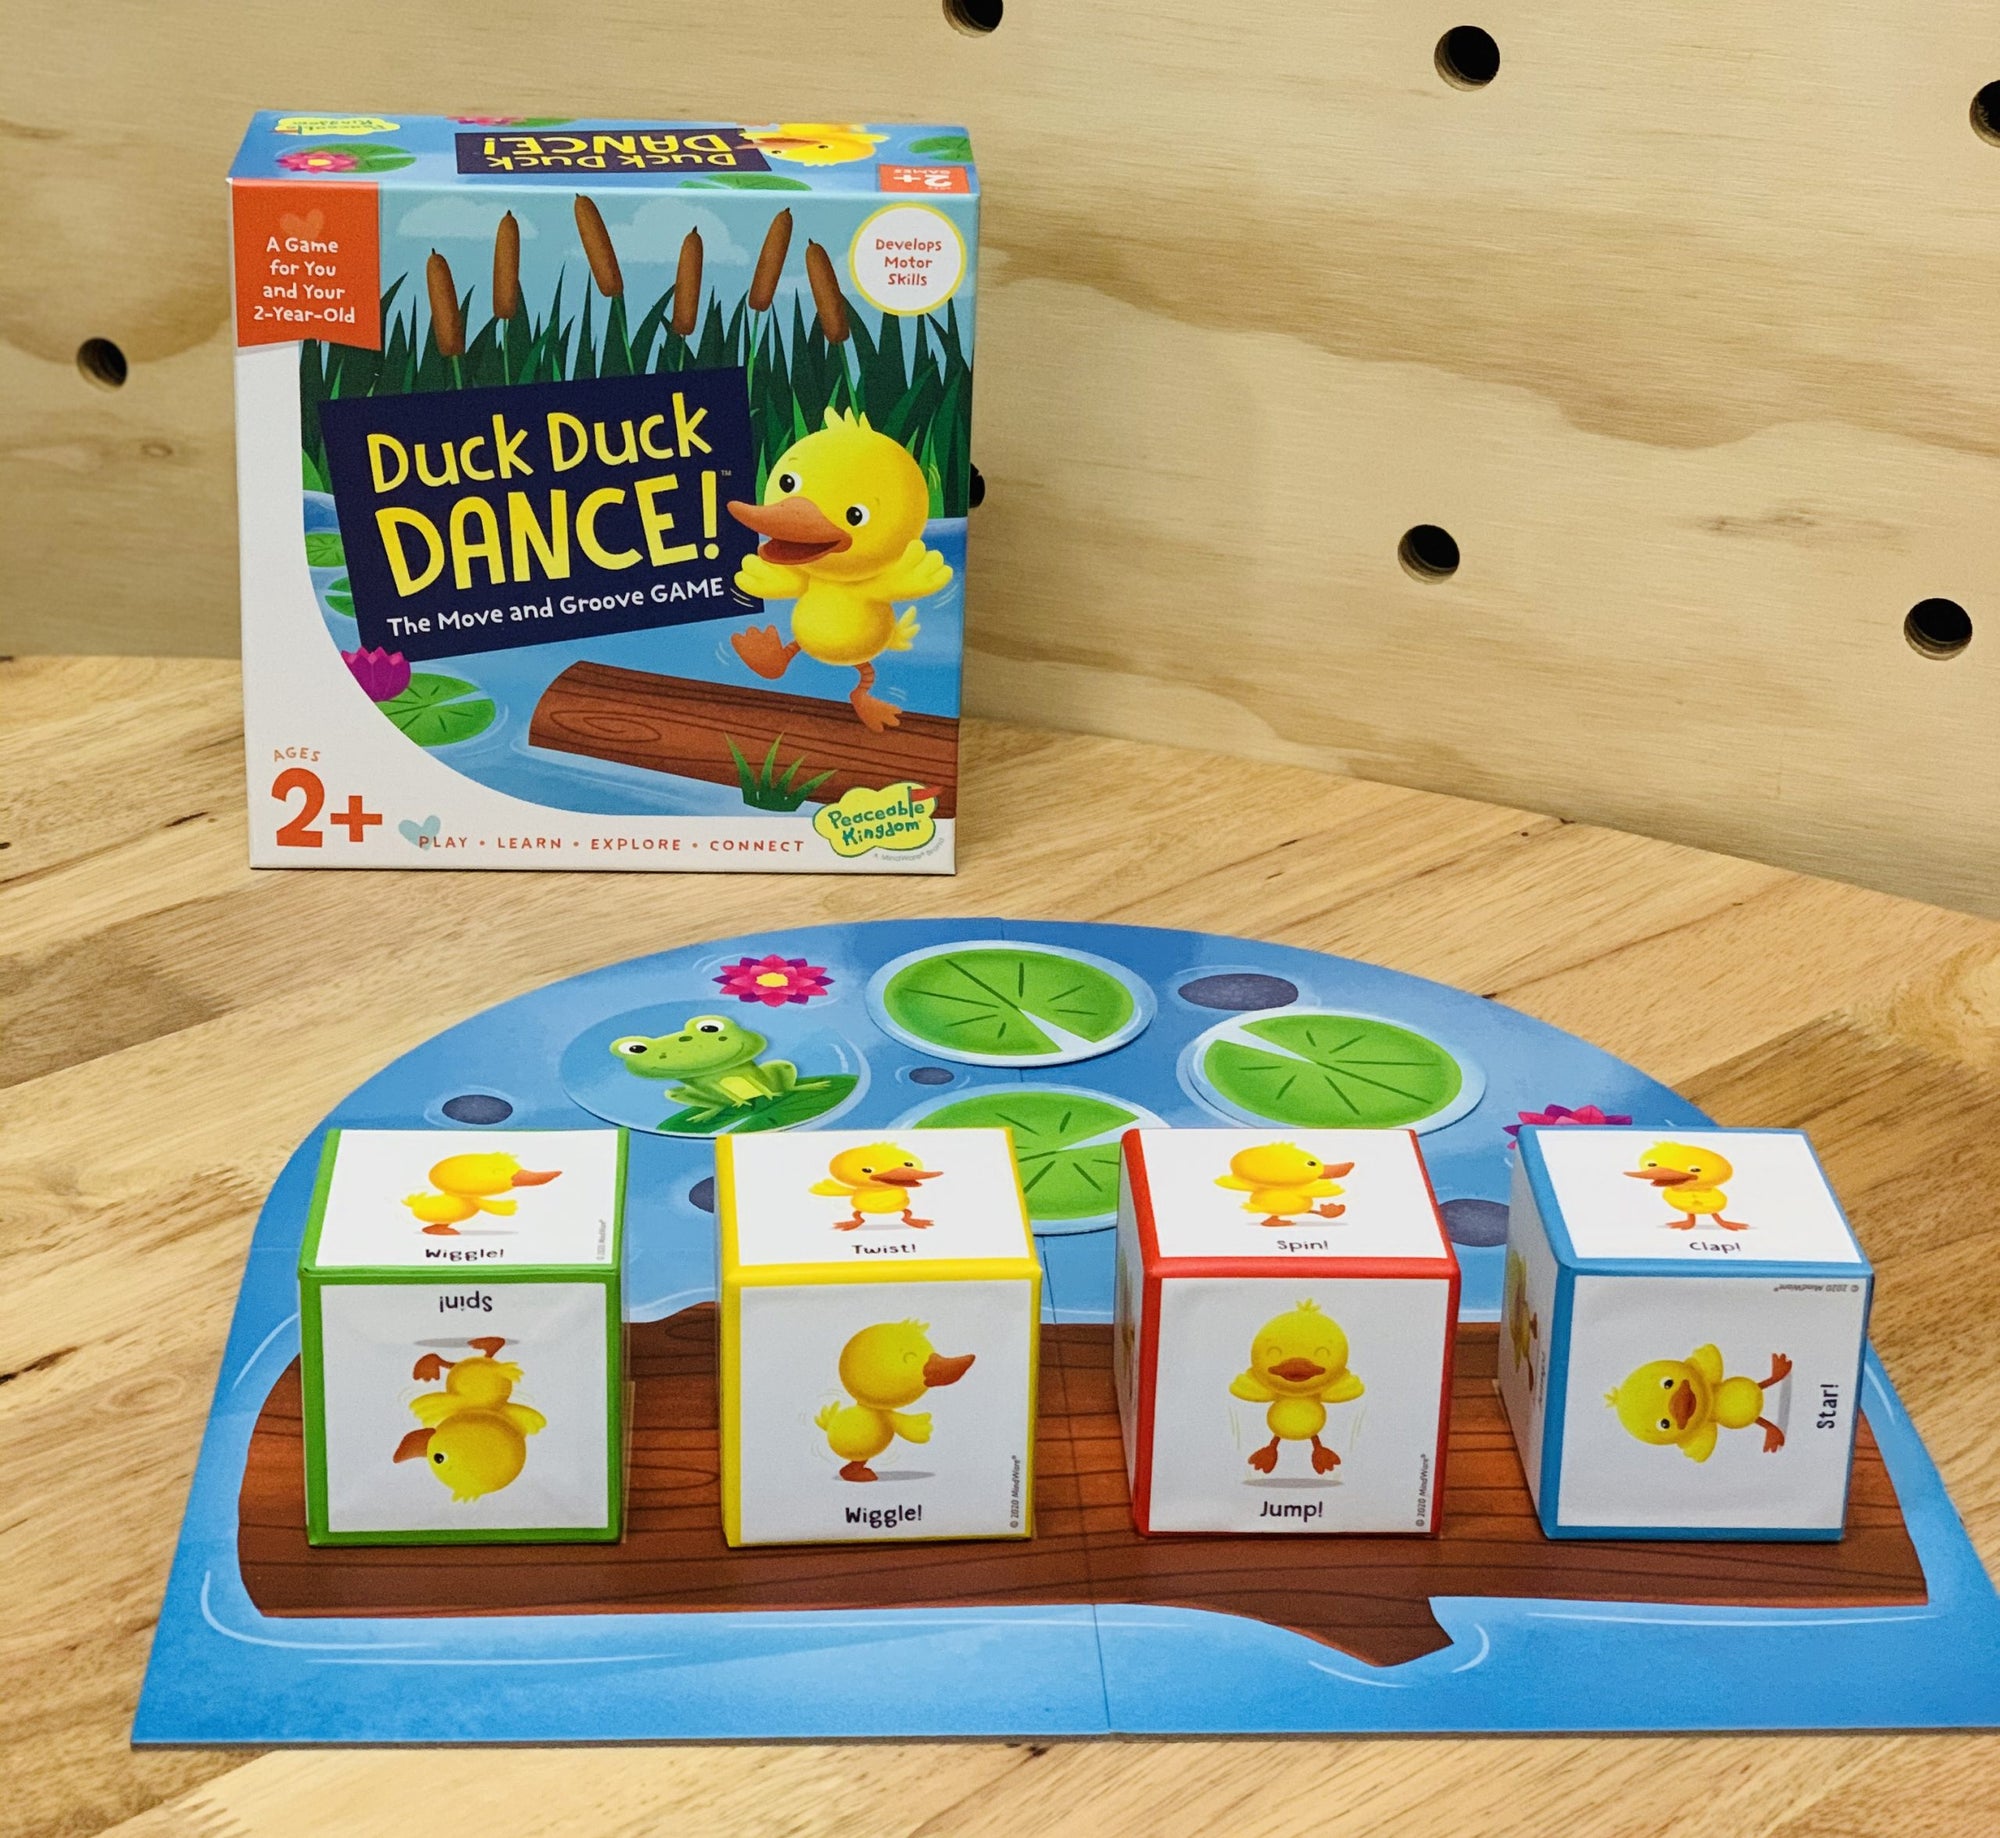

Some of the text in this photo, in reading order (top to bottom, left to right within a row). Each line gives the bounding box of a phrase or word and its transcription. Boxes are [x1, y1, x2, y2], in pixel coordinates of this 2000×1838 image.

[484, 134, 732, 156] DANCE!
[486, 153, 737, 171] Duck Duck
[893, 174, 953, 188] 2+
[266, 236, 339, 253] A Game
[875, 238, 942, 253] Develops
[269, 258, 337, 277] for You
[884, 256, 933, 269] Motor
[887, 273, 928, 286] Skills
[262, 282, 346, 300] and Your
[253, 305, 356, 324] 2-Year-Old
[366, 391, 713, 494] Duck Duck
[374, 470, 720, 598] DANCE!
[387, 577, 726, 637] The Move and Groove GAME
[273, 746, 321, 762] AGES
[271, 767, 383, 848] 2+
[828, 786, 925, 829] Peaceable
[842, 821, 920, 846] Kingdom
[419, 836, 805, 853] PLAY LEARN EXPLORE CONNECT
[852, 1243, 917, 1255] Twist!
[1276, 1240, 1328, 1252] Spin!
[1689, 1241, 1741, 1254] Clap!
[425, 1249, 504, 1262] Wiggle!
[1825, 1284, 1848, 1293] 2020
[438, 1290, 493, 1313] Spin!
[1816, 1384, 1839, 1429] Star!
[845, 1504, 922, 1529] Wiggle!
[1010, 1500, 1019, 1518] 2020
[1260, 1501, 1323, 1523] Jump!
[1417, 1498, 1426, 1518] 2020
